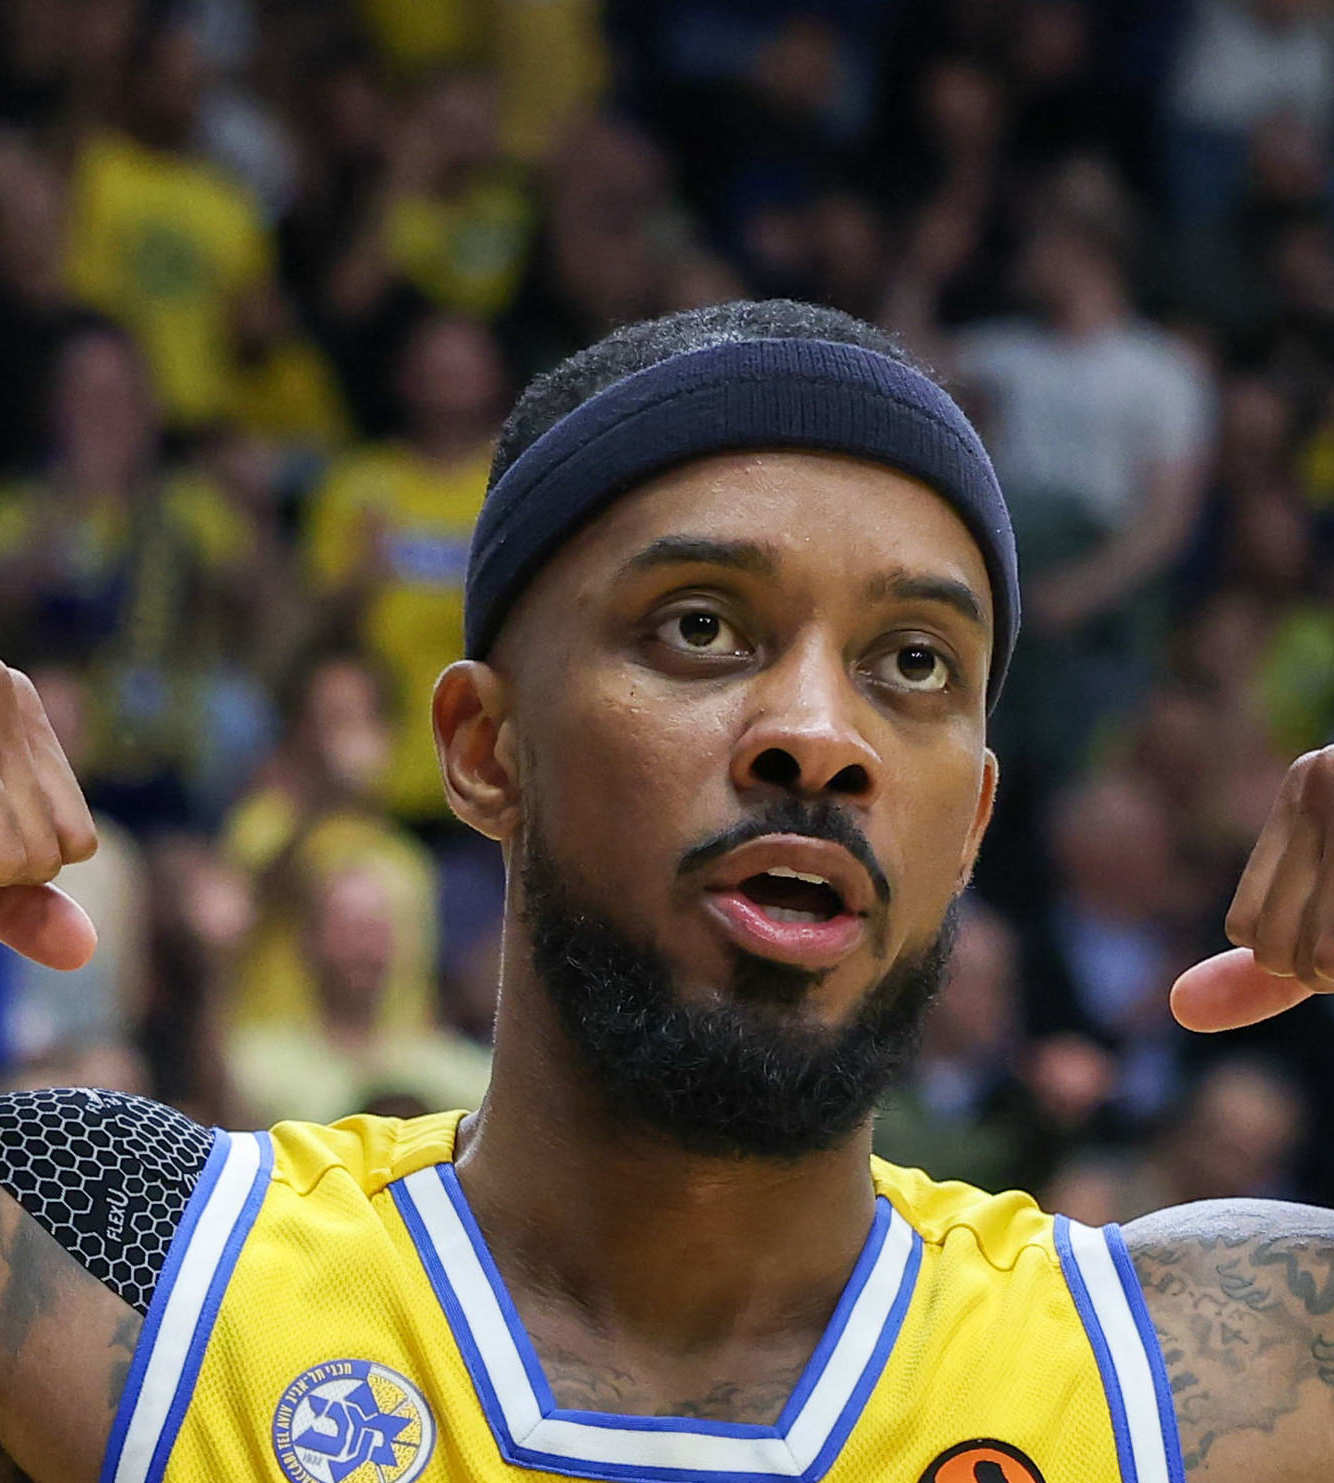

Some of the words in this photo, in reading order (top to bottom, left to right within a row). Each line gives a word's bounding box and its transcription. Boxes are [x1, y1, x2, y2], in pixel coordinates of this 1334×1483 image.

[105, 1187, 129, 1242] FLEXU
[276, 1404, 293, 1429] AVIV
[276, 1431, 291, 1450] TEL
